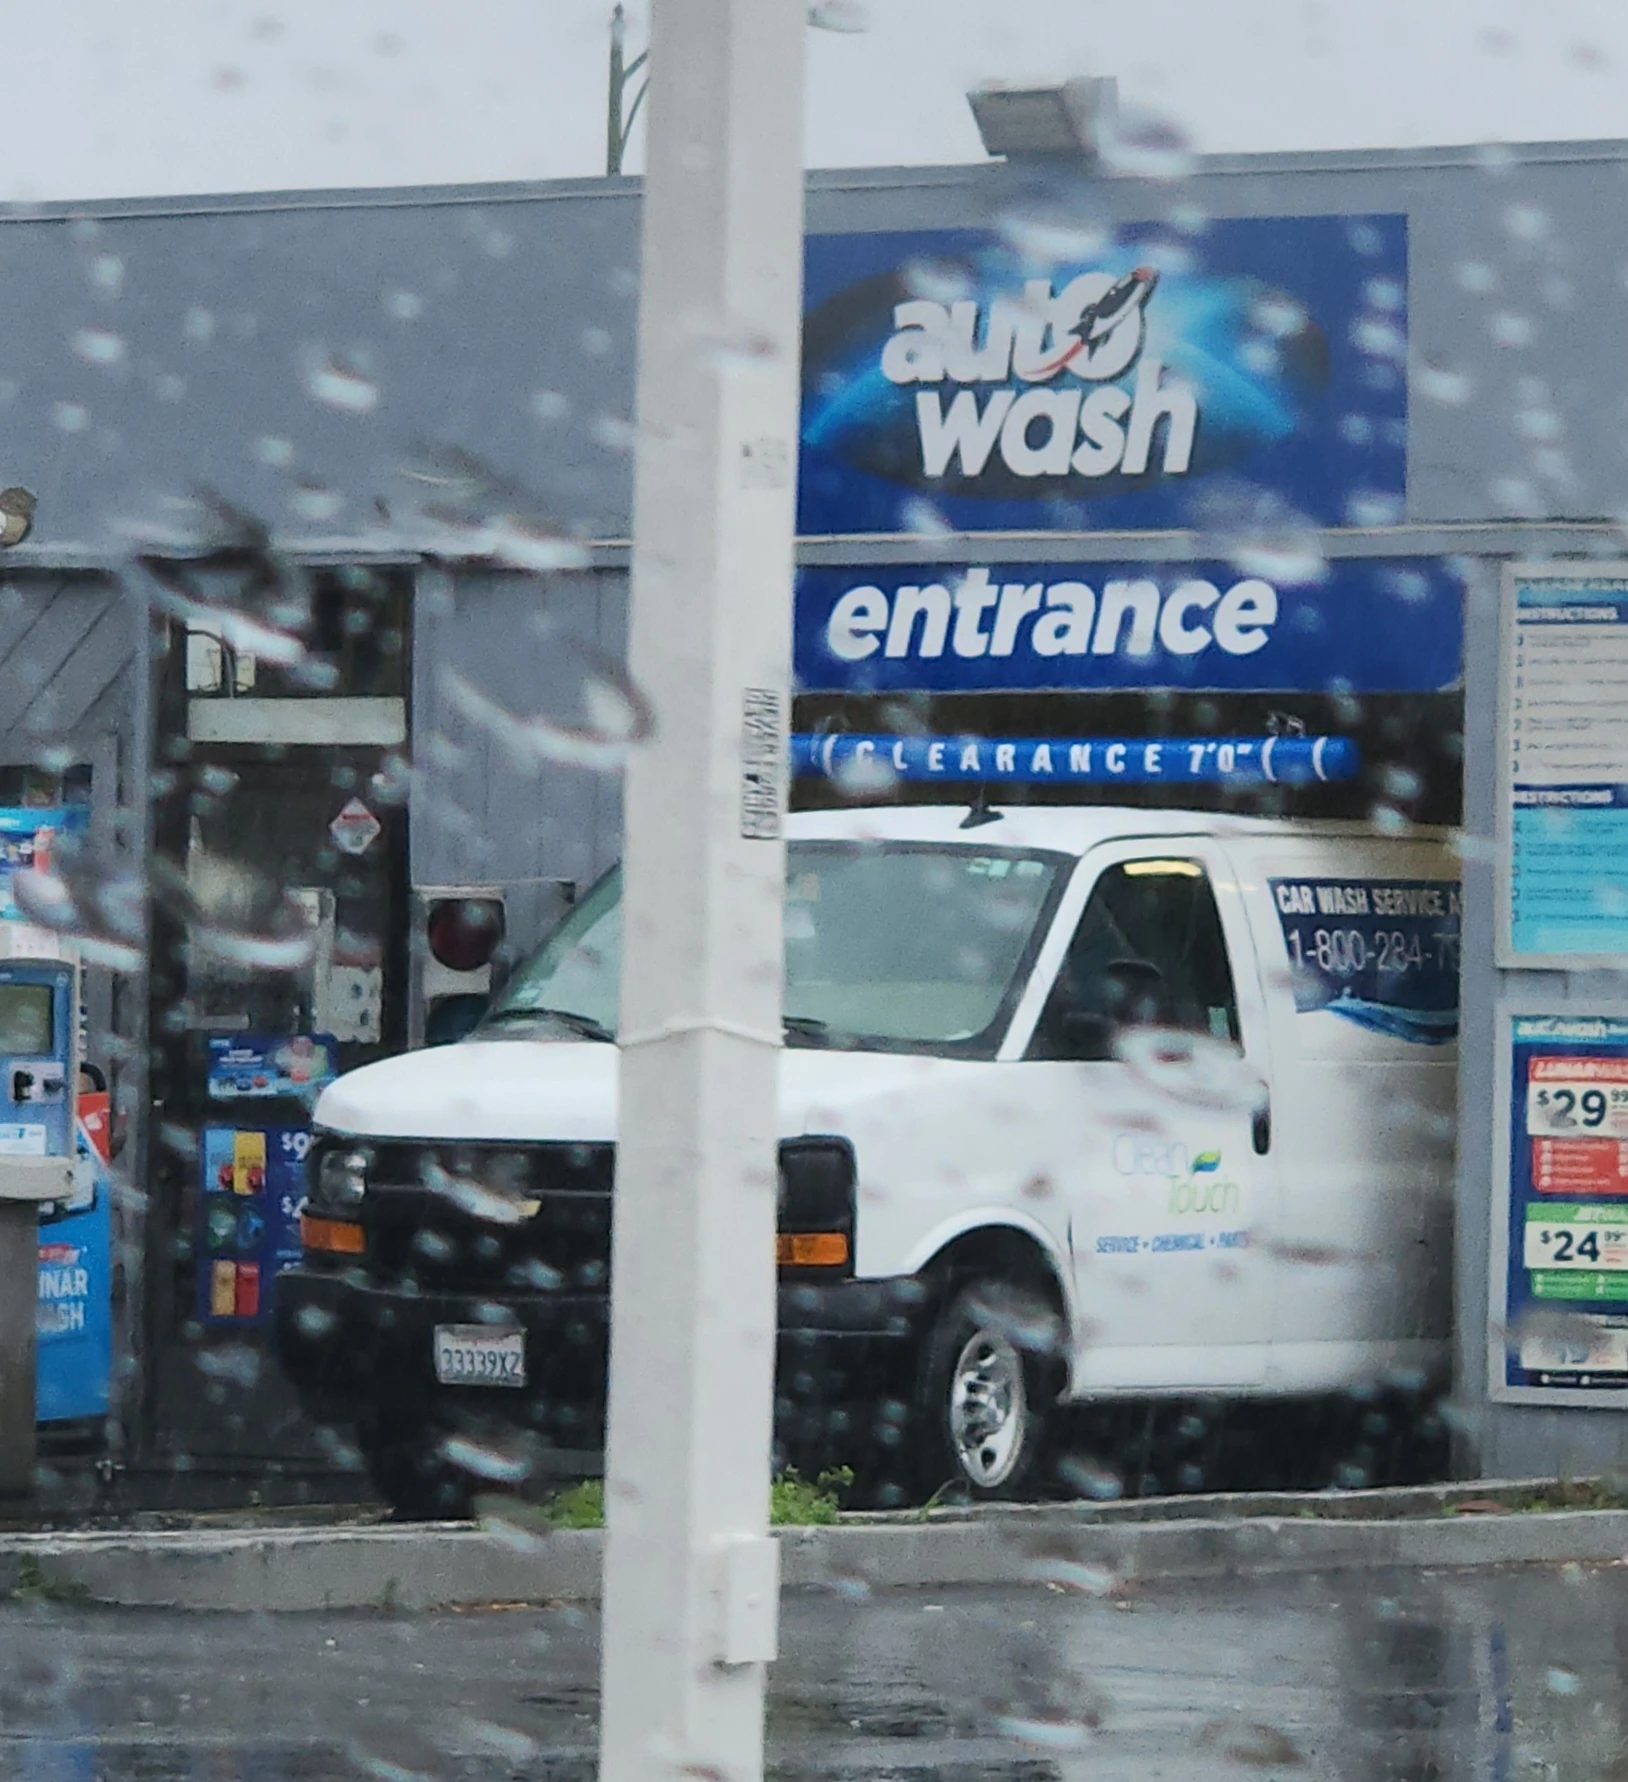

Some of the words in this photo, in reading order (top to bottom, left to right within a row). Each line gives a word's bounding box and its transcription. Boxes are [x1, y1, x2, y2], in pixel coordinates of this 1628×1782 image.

[880, 271, 1147, 384] auto
[915, 360, 1197, 477] wash
[826, 567, 1279, 661] entrance
[855, 740, 1162, 774] CLEARANCE
[1276, 884, 1315, 915] CAR
[1315, 885, 1370, 915] WASH
[1371, 887, 1446, 916] SERVICE
[1167, 1173, 1241, 1215] Touch
[1540, 1230, 1601, 1263] $24
